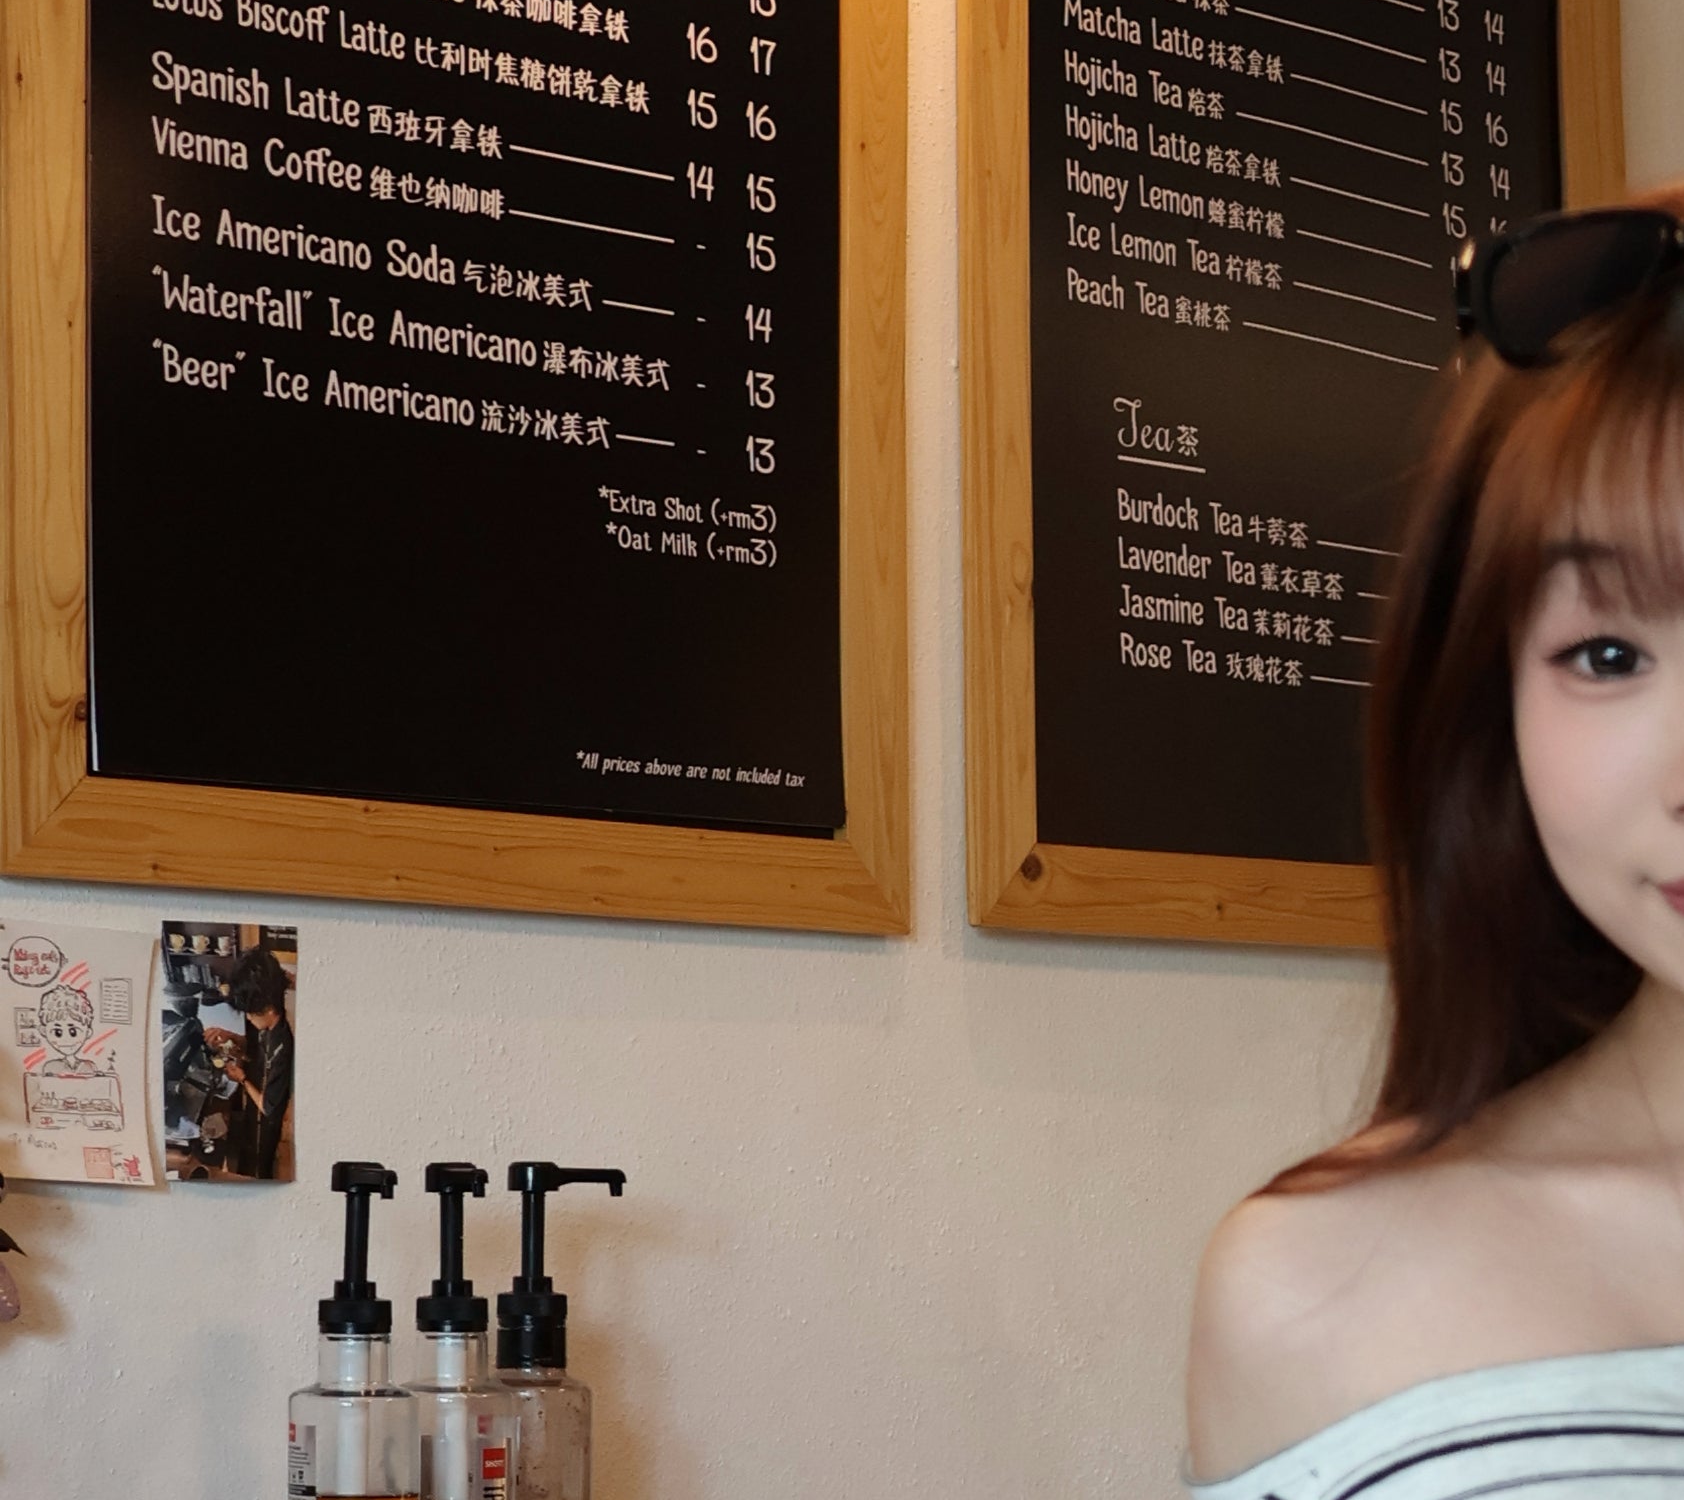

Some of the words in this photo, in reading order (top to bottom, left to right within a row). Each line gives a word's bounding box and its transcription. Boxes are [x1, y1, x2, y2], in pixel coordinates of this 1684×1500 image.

[339, 10, 406, 60] Latte
[687, 88, 718, 130] 15
[745, 101, 777, 141] 16
[686, 22, 718, 64] 16
[749, 36, 777, 76] 17
[1151, 17, 1204, 61] Latte
[1207, 39, 1284, 84] 抹茶拿铁
[1439, 99, 1463, 135] 15
[1438, 47, 1461, 83] 13
[151, 50, 269, 110] Spanish
[284, 76, 361, 128] Latte
[366, 104, 503, 160] 西班牙拿铁
[686, 161, 715, 202] 14
[746, 173, 777, 213] 15
[1064, 48, 1138, 98] Hojicha
[1147, 69, 1183, 109] Tea
[1441, 151, 1465, 186] 13
[151, 115, 249, 171] Vienna
[264, 137, 363, 192] Coffee
[369, 165, 505, 221] 维也纳咖啡
[746, 232, 776, 272] 15
[1065, 103, 1139, 152] Hojicha
[1148, 123, 1201, 166] Latte
[1442, 202, 1467, 239] 15
[1066, 158, 1129, 214] Honey
[1138, 174, 1204, 220] Lemon
[151, 193, 201, 241] Ice
[216, 208, 372, 271] Americano
[386, 238, 456, 286] Soda
[462, 259, 593, 312] 气泡冰美式
[745, 304, 773, 344] 14
[1066, 211, 1101, 251] Ice
[1110, 222, 1177, 267] Lemon
[1186, 238, 1221, 276] Tea
[1067, 266, 1125, 310] Peach
[1134, 281, 1170, 318] Tea
[1174, 295, 1231, 332] 蜜桃茶
[328, 296, 375, 342] Ice
[389, 309, 537, 367] Americano
[745, 369, 776, 409] 13
[262, 357, 309, 402] Ice
[324, 369, 475, 426] Americano
[480, 399, 611, 449] 流沙冰美式
[745, 435, 776, 474] 13
[1113, 396, 1175, 453] Tea
[1176, 424, 1199, 457] 茶
[664, 497, 704, 524] Shot
[1117, 487, 1199, 532] Burdock
[1208, 501, 1244, 537] Tea
[661, 531, 698, 558] Milk
[1118, 535, 1212, 580] Lavender
[1221, 550, 1257, 586] Tea
[1119, 583, 1204, 626] Jasmine
[1213, 596, 1249, 631] Tea
[1252, 608, 1334, 646] 茉莉花茶
[1120, 632, 1172, 670] Rose
[1181, 639, 1218, 674] Tea
[601, 758, 641, 775] prices
[644, 757, 683, 777] above
[685, 765, 708, 779] are
[711, 767, 731, 781] not
[735, 766, 782, 786] included
[785, 772, 806, 787] tax
